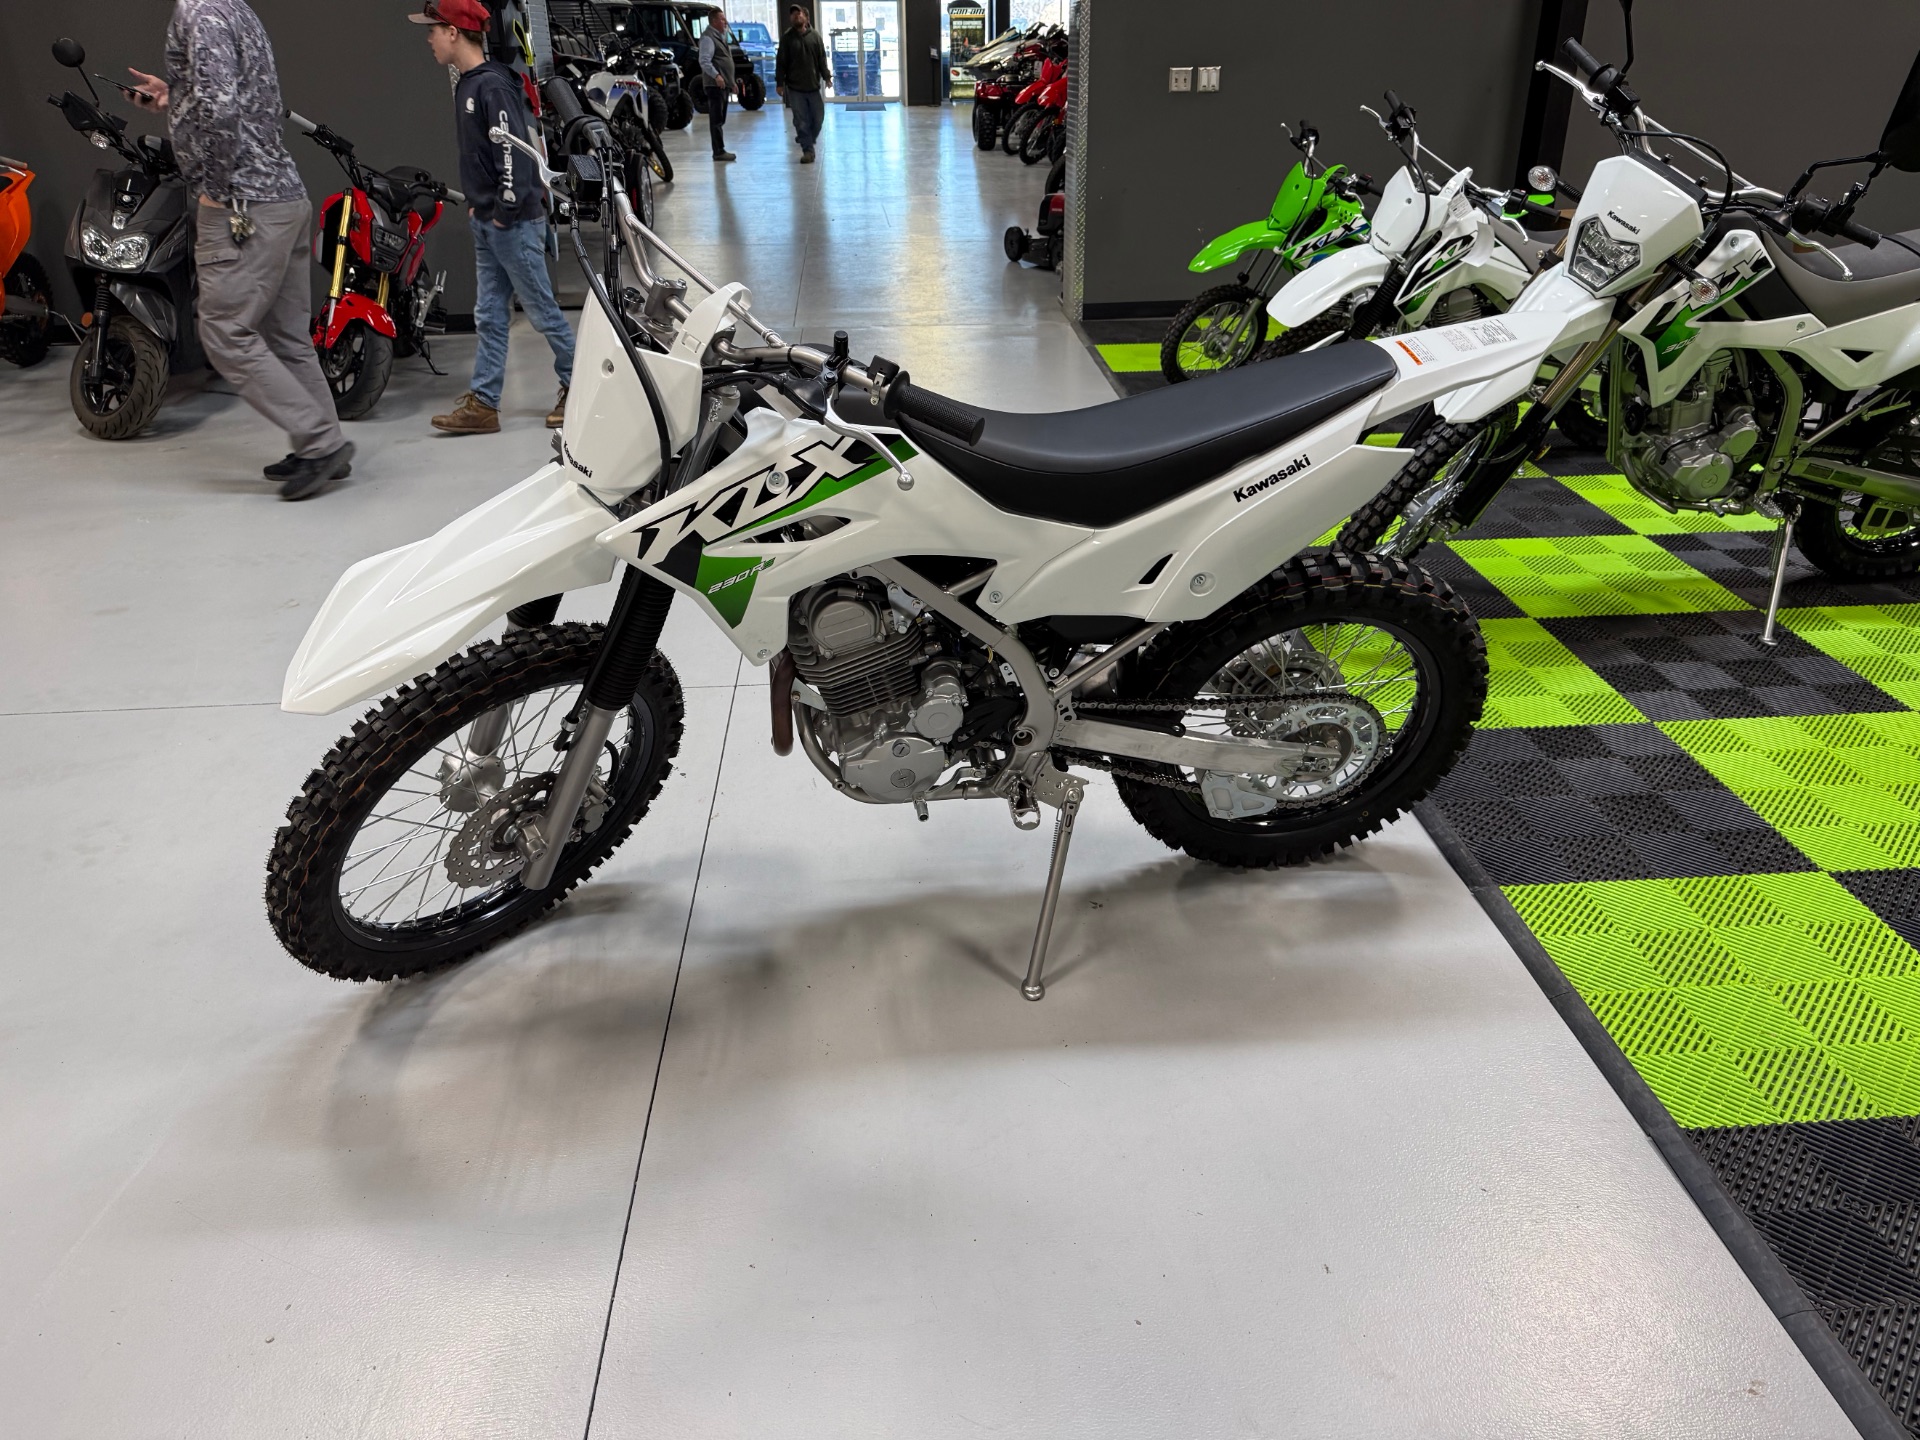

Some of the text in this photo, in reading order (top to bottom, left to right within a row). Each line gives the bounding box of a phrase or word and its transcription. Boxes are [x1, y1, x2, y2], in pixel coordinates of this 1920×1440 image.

[499, 110, 514, 189] cahartt
[1293, 216, 1359, 259] KLX
[1607, 210, 1641, 235] Kawasaki
[643, 434, 869, 567] KLX
[1233, 454, 1311, 503] Kawasaki
